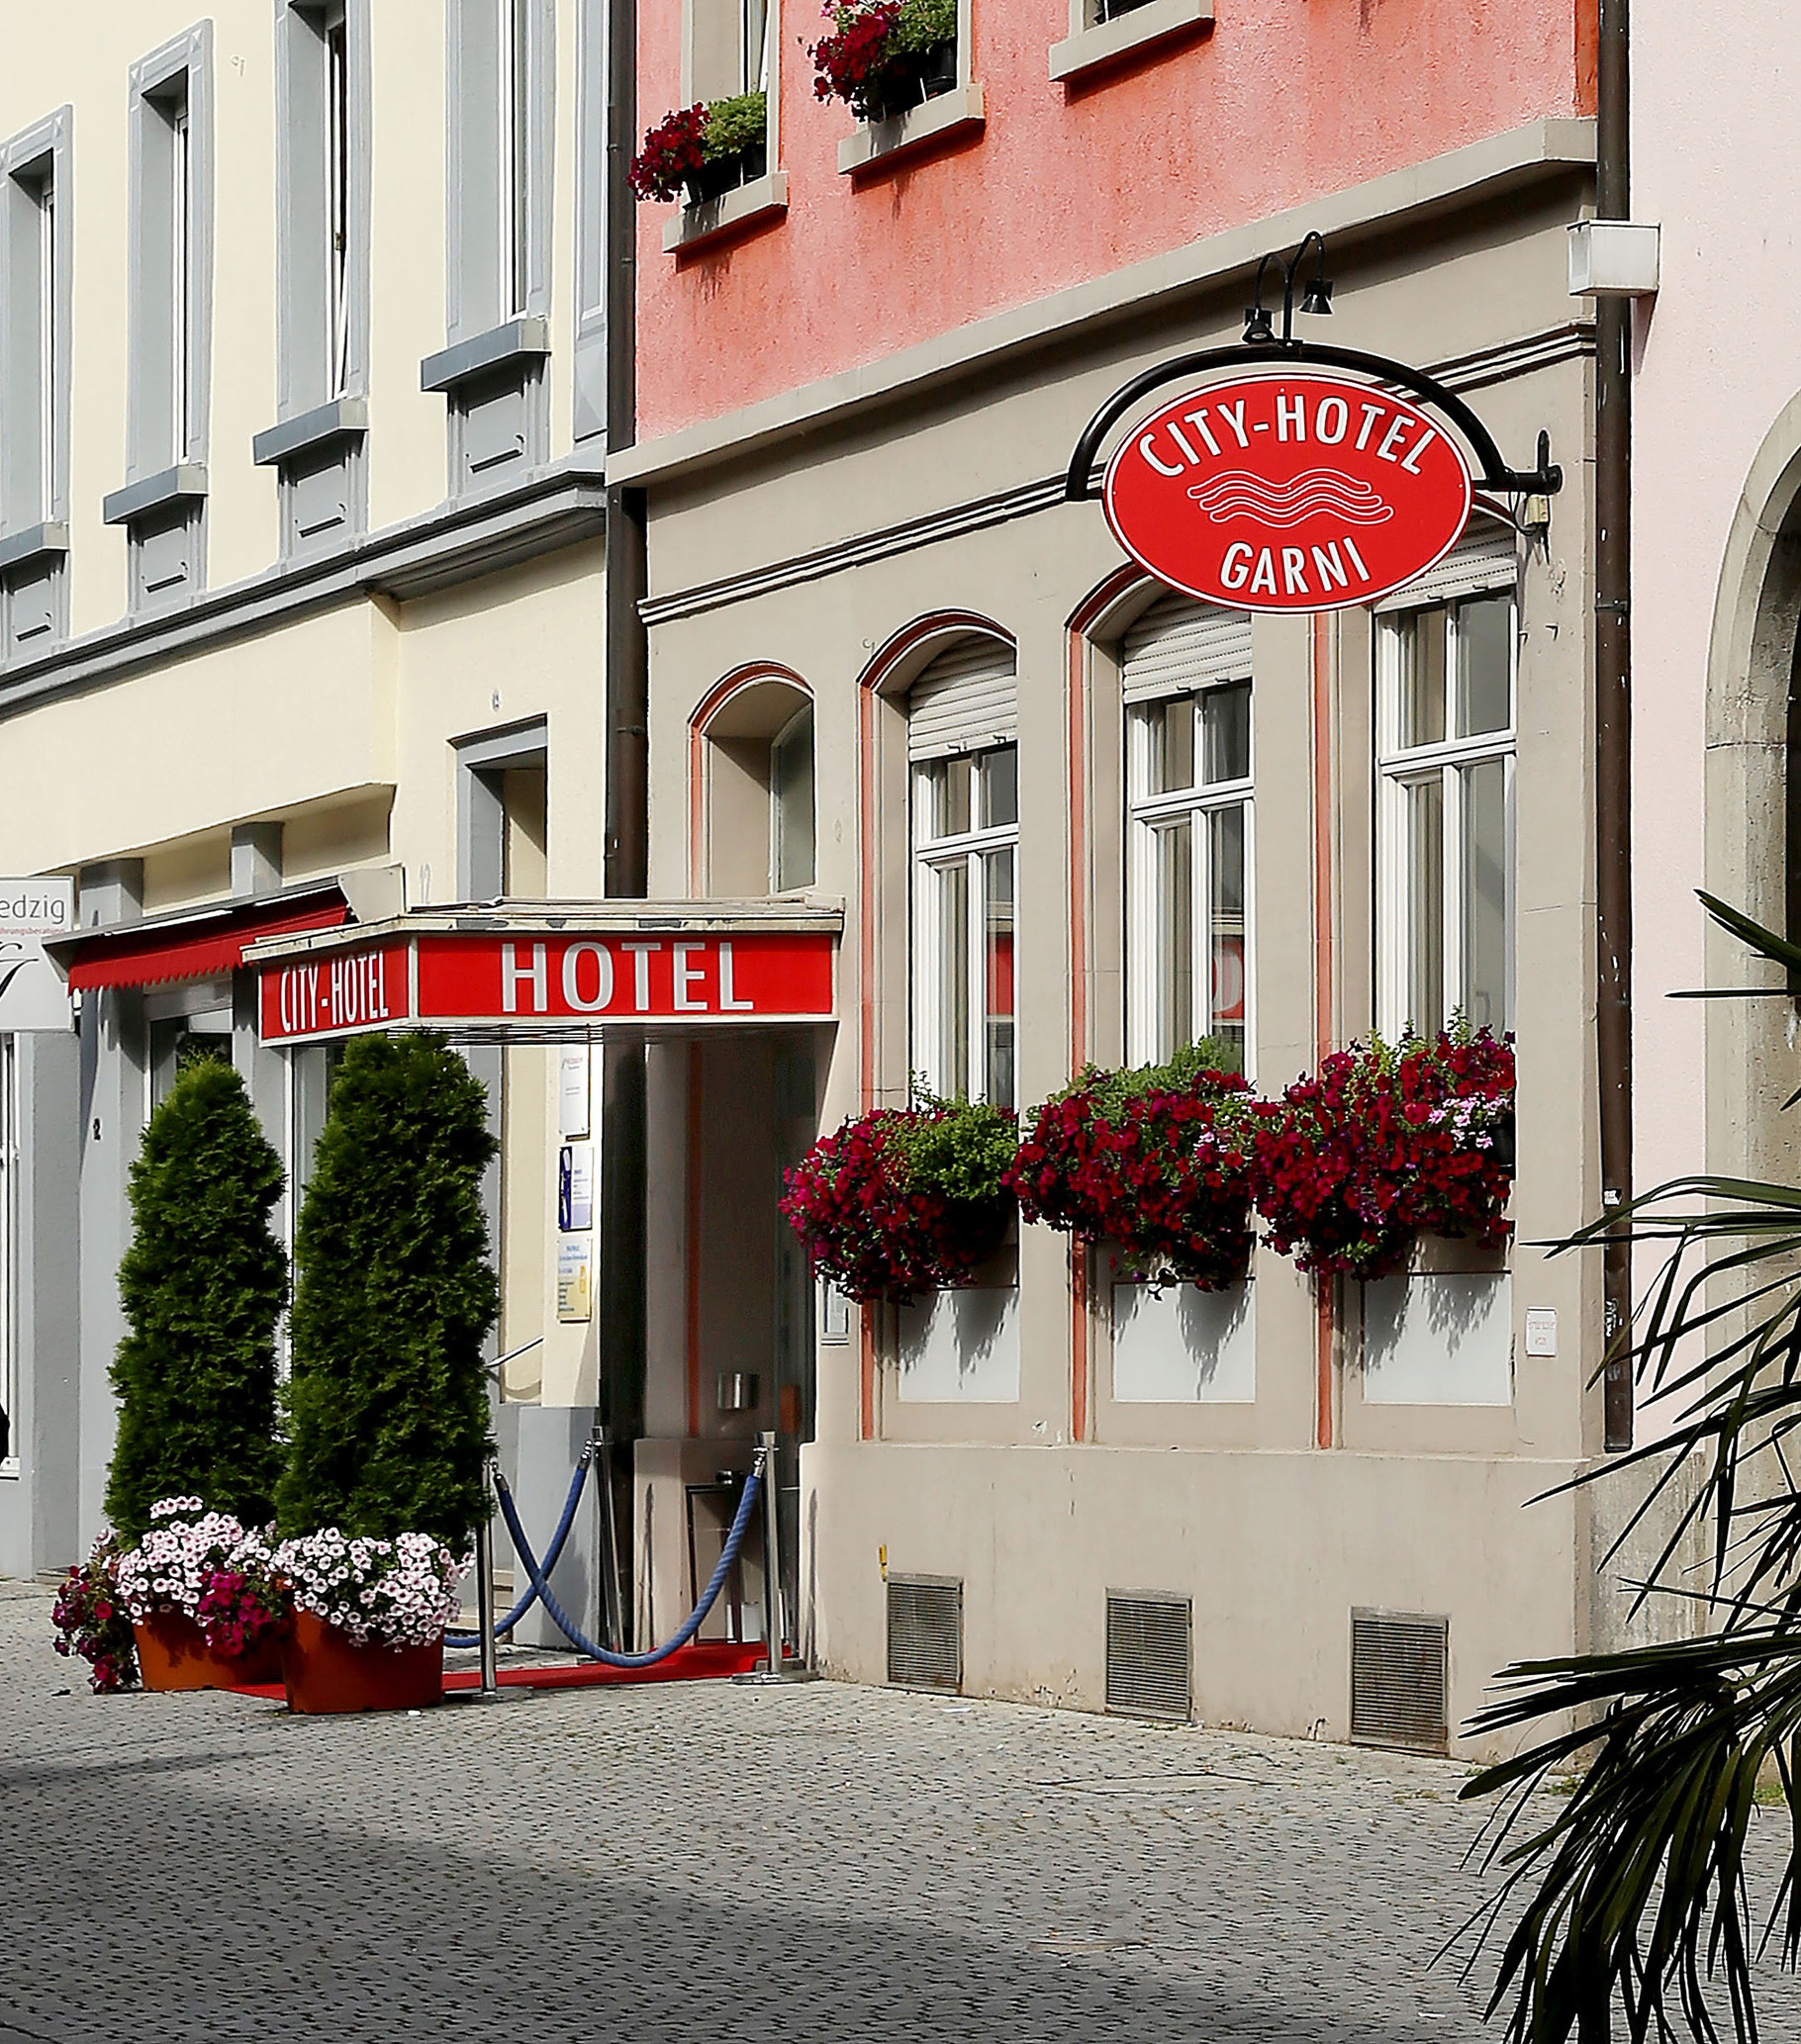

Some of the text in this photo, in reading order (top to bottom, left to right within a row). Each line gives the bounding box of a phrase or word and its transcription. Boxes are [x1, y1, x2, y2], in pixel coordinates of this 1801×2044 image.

[1139, 395, 1437, 477] CITY-HOTEL
[1220, 537, 1371, 596] GARNI
[0, 894, 64, 925] edzig
[502, 942, 754, 1012] HOTEL
[93, 1118, 101, 1141] 2
